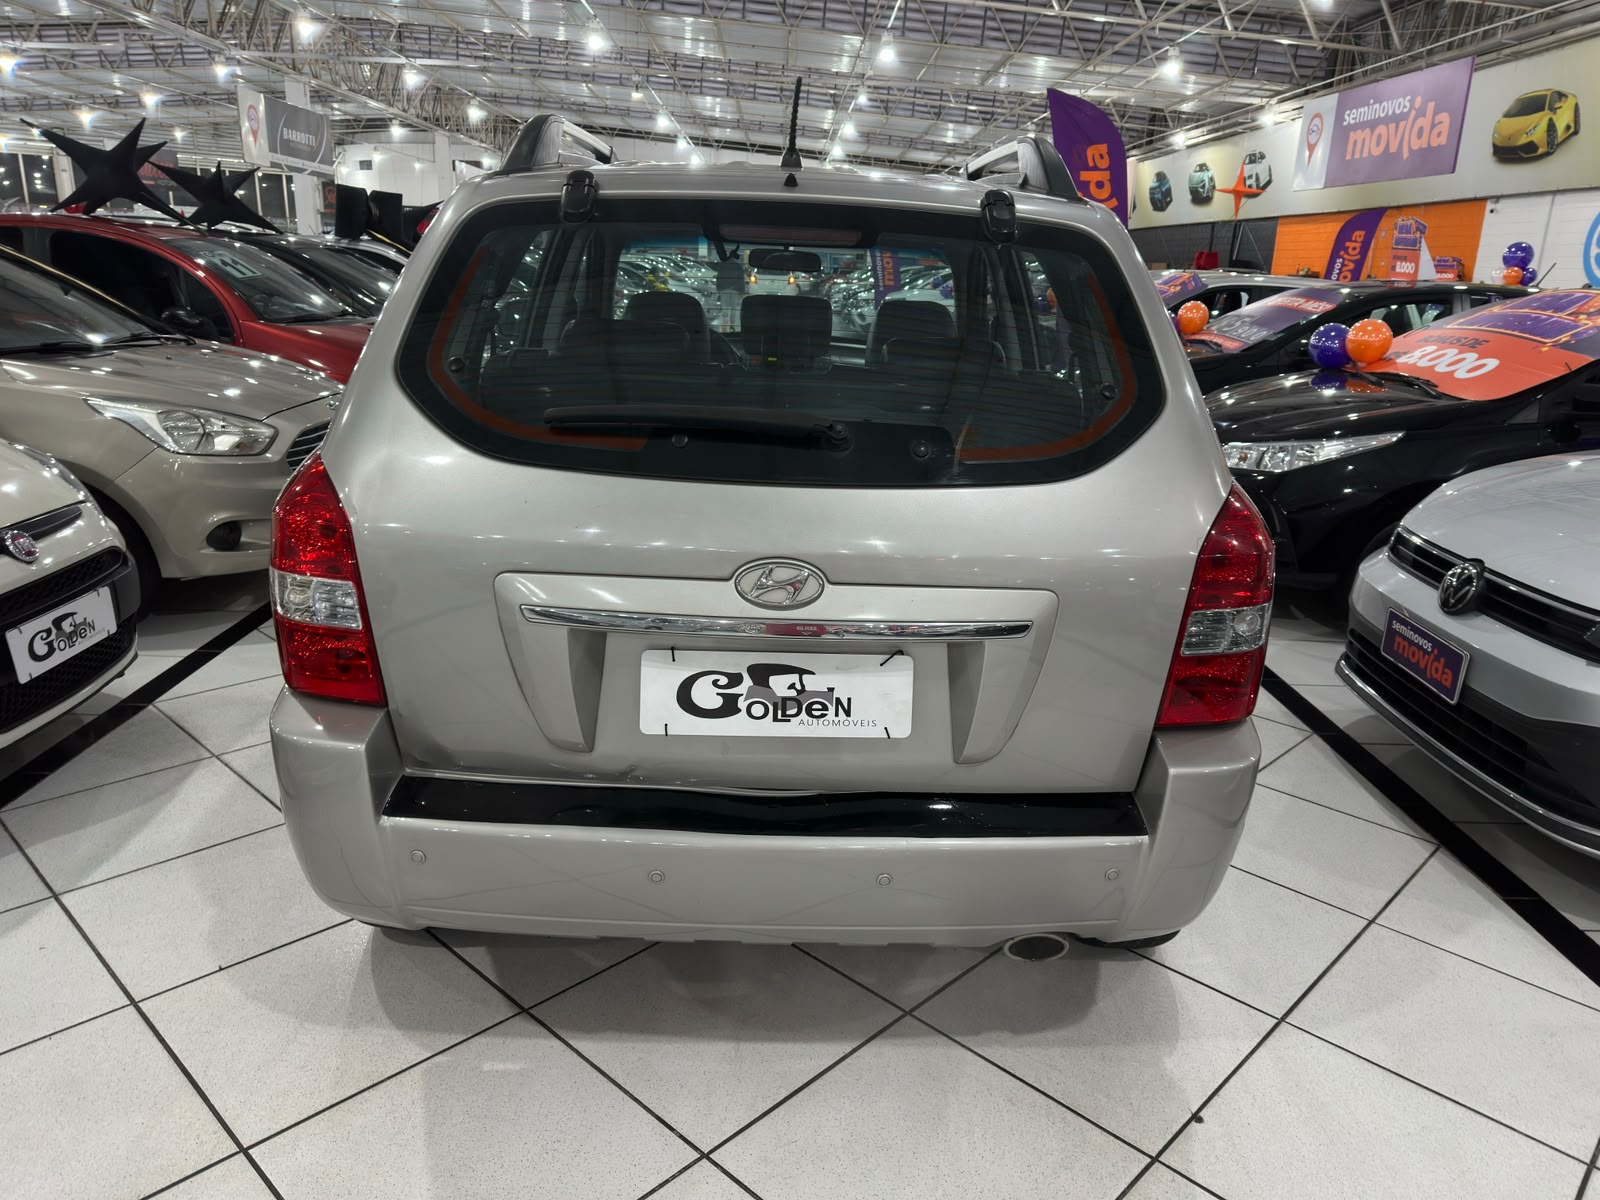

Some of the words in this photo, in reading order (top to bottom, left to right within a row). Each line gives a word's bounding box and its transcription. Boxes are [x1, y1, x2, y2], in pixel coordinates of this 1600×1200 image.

[1343, 95, 1411, 126] seminovos
[1345, 96, 1450, 160] movida
[1395, 345, 1500, 379] 8.000
[1391, 620, 1433, 652] seminovos
[1393, 635, 1453, 689] movida
[798, 717, 877, 728] AUTOMÓVEIS
